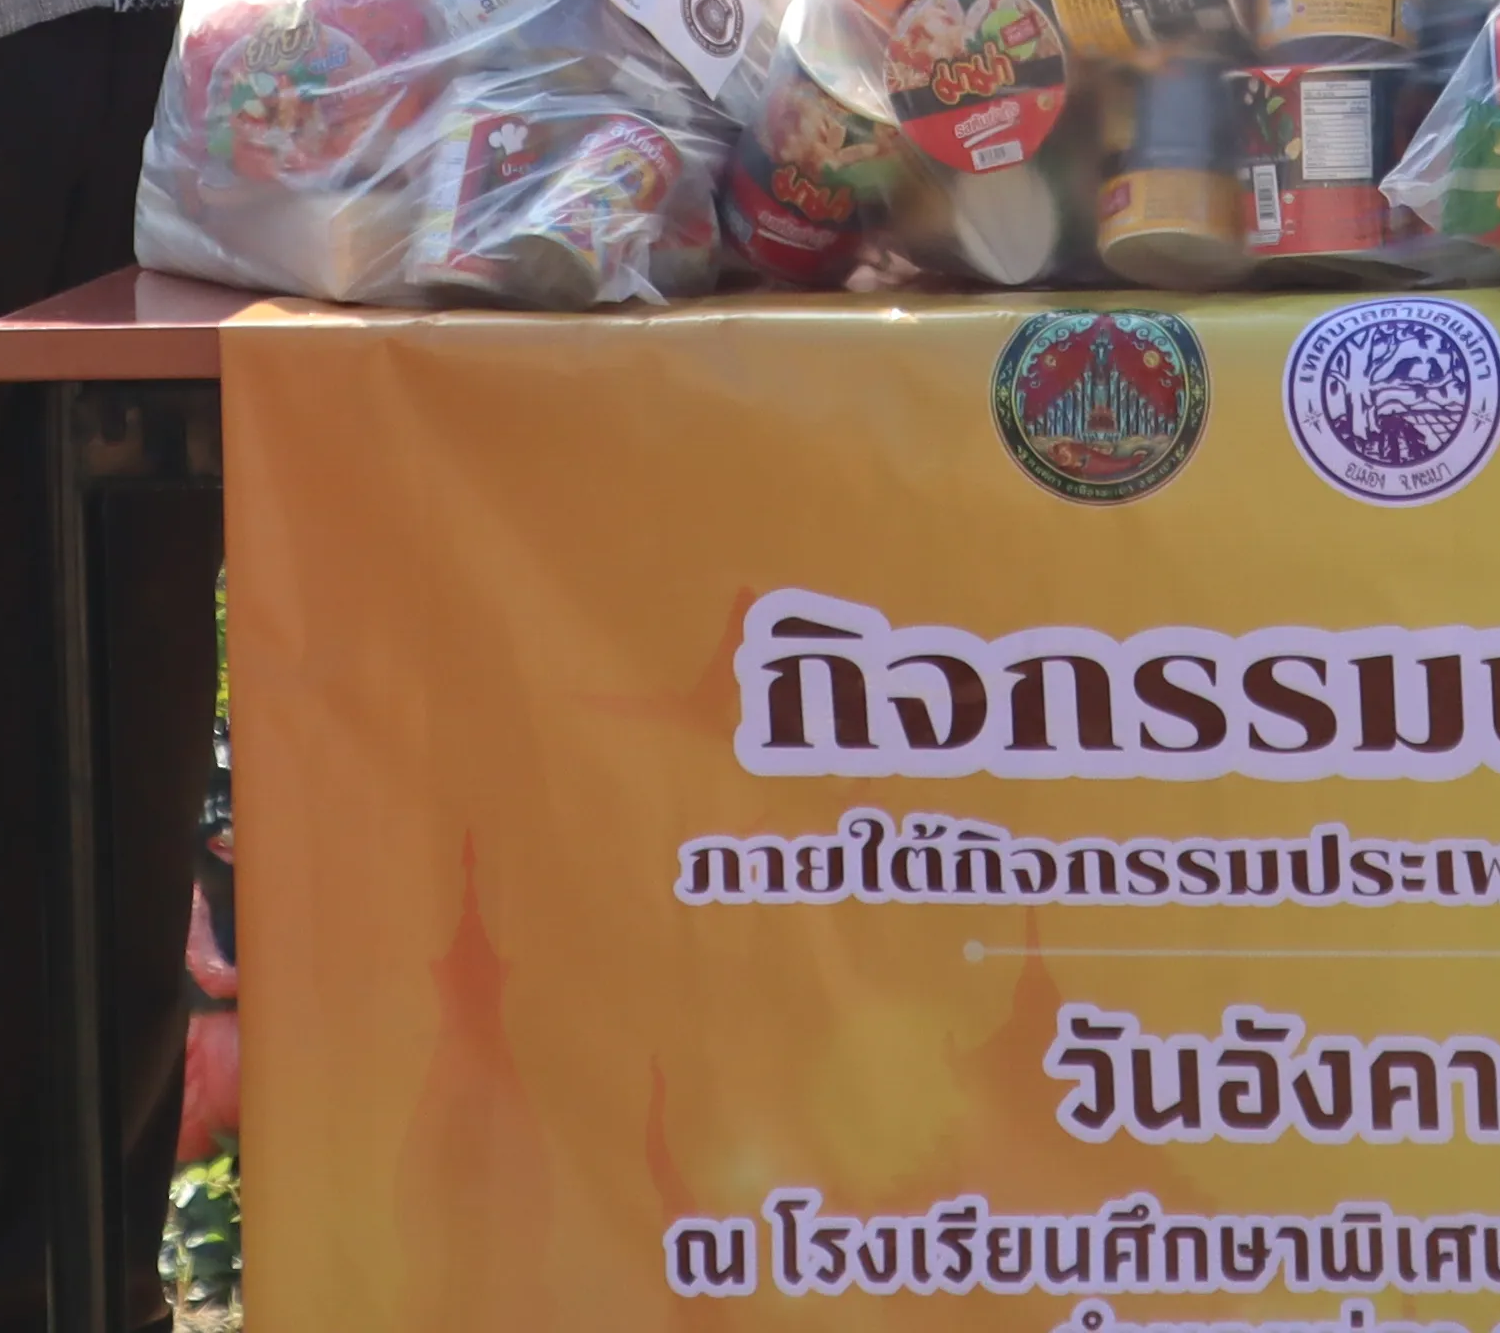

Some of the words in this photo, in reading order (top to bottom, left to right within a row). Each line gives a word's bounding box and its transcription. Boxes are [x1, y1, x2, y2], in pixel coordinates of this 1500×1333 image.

[1299, 302, 1492, 383] เทศบาลตำบลแม่กา
[674, 1227, 746, 1286] ณ
